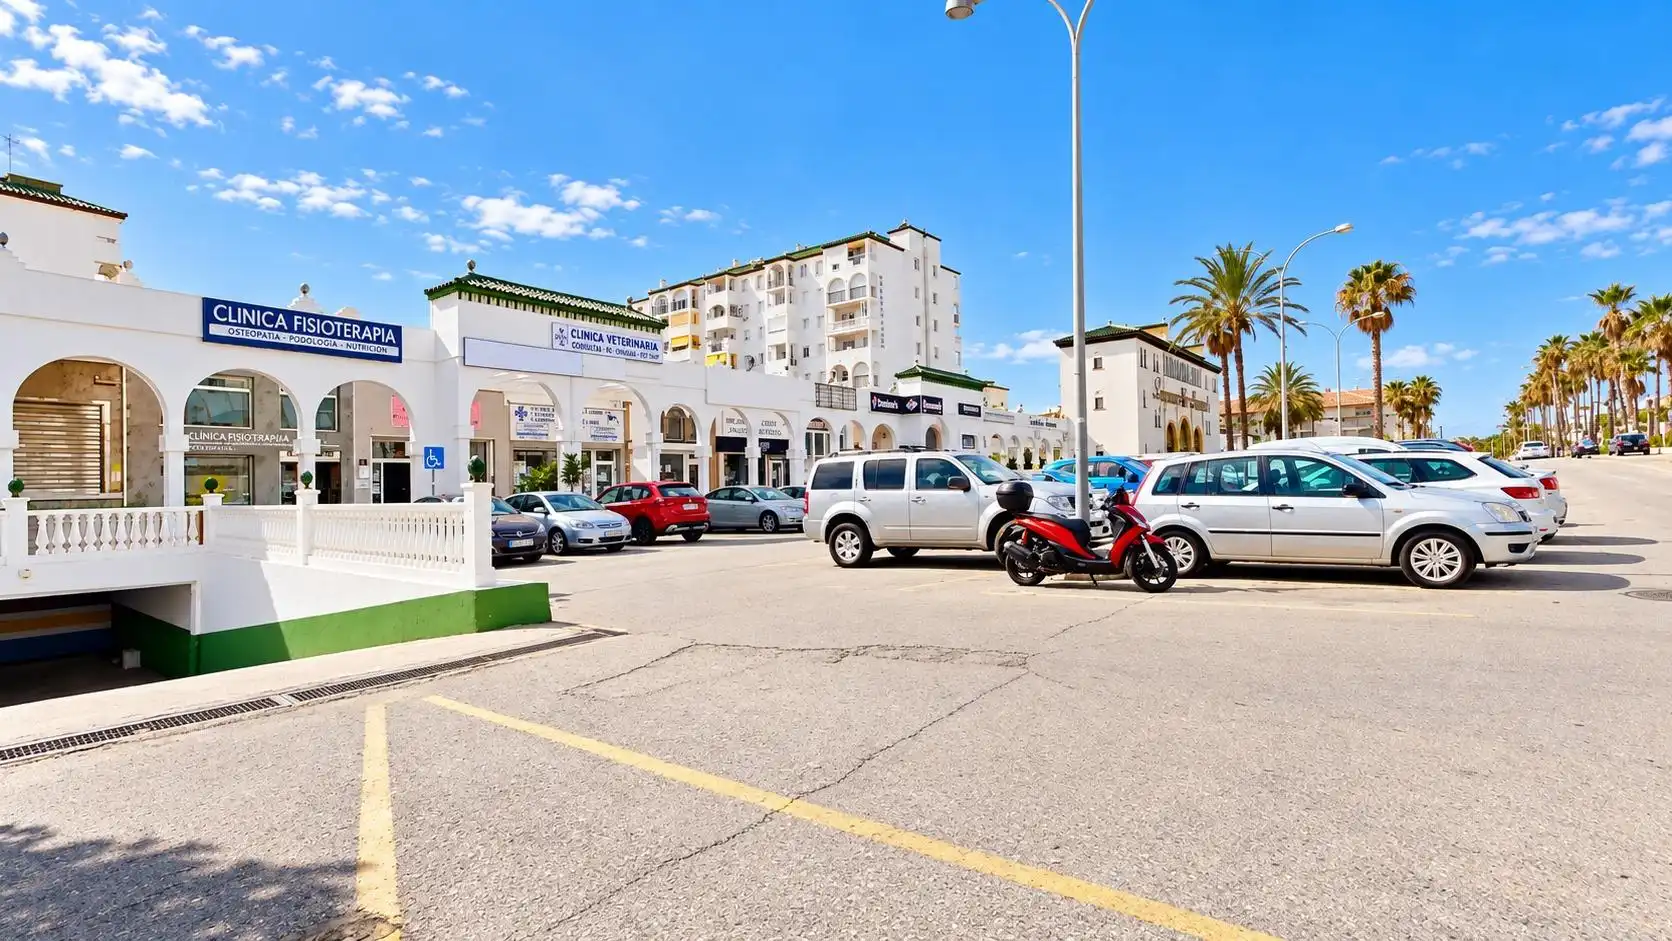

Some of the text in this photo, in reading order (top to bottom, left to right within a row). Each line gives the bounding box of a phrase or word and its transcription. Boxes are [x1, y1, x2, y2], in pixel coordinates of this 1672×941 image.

[213, 304, 396, 344] CLINICA FISIOTERAPIA
[228, 327, 281, 341] OSTEOPATIA
[288, 335, 338, 348] PODOLOGIA
[346, 343, 388, 354] NUTRICION
[570, 328, 605, 344] CLINICA
[606, 334, 659, 352] VETERINARIA
